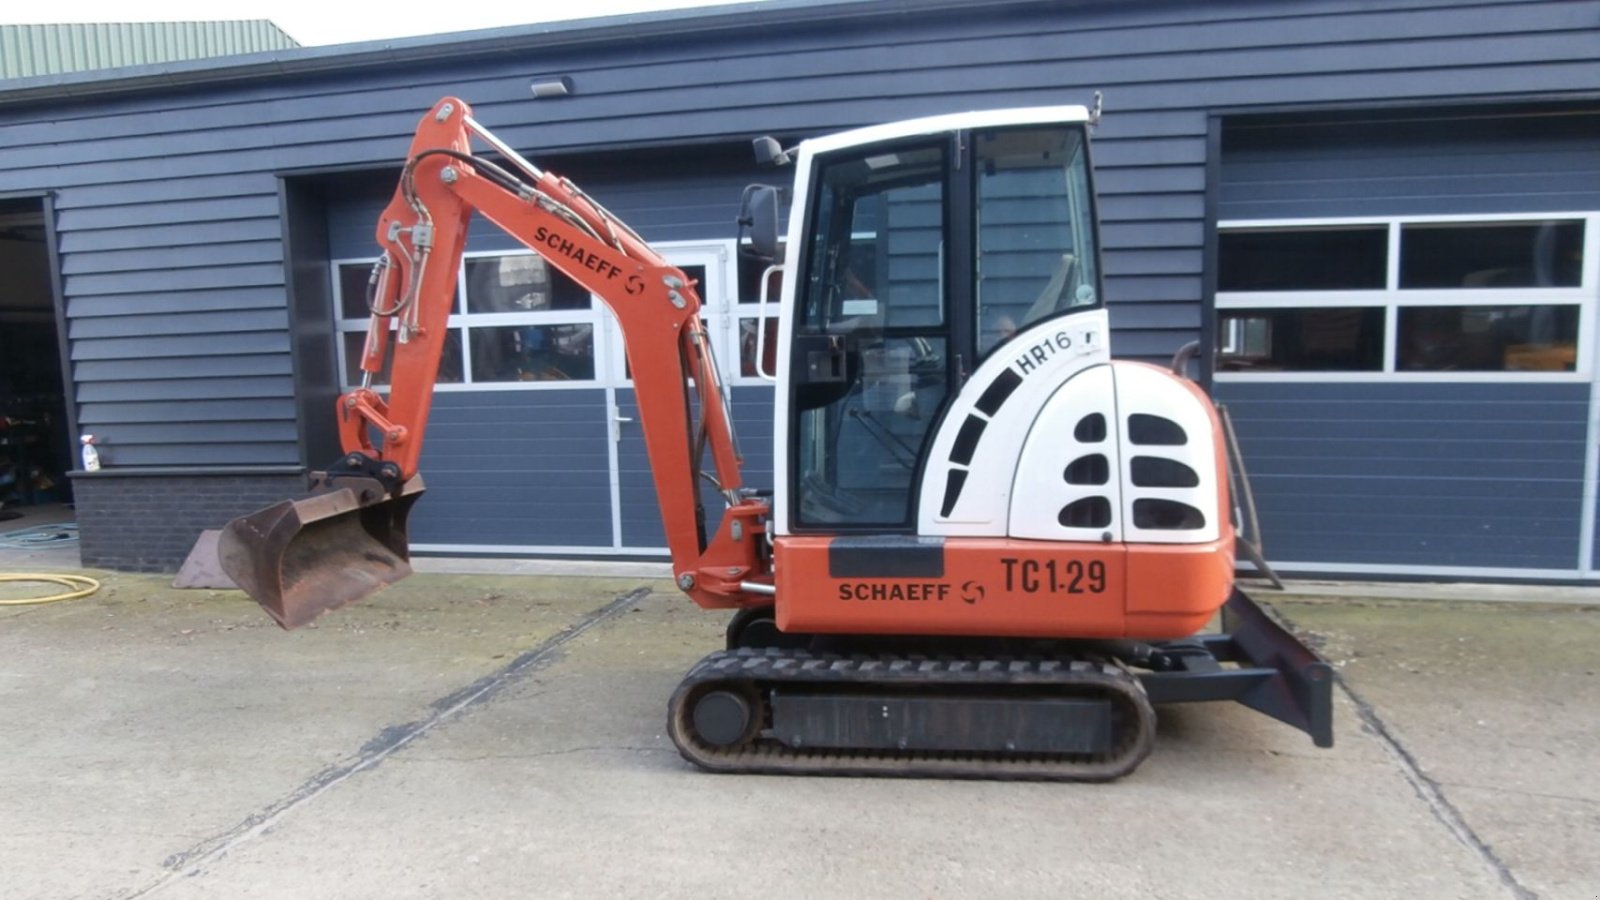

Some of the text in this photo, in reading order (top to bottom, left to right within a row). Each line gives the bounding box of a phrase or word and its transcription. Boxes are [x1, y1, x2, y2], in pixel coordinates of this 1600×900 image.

[534, 226, 622, 279] SCHAEFF
[1015, 331, 1072, 375] HR16
[838, 583, 952, 601] SCHAEFF
